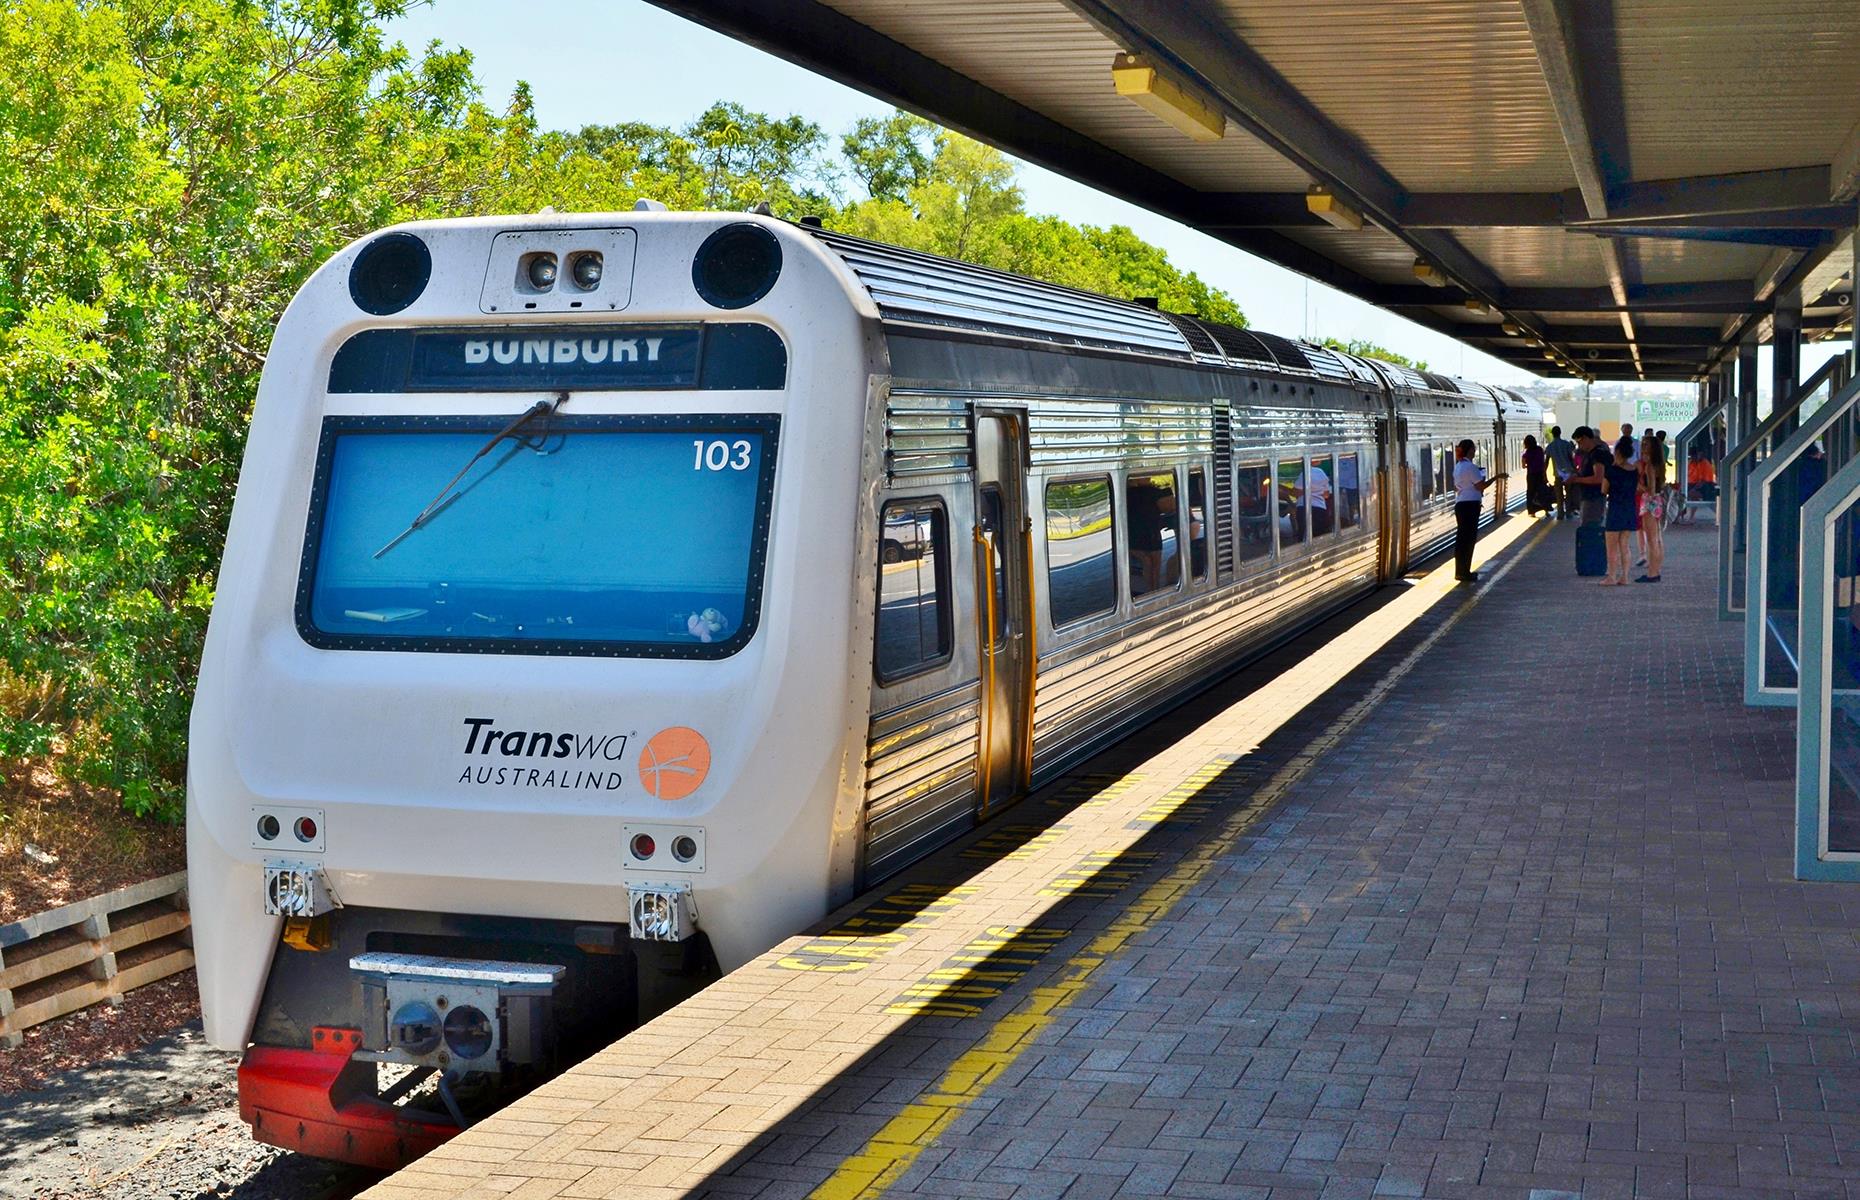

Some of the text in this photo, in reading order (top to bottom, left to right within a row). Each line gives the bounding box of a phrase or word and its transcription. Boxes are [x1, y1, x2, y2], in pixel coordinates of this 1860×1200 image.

[465, 337, 663, 364] BUNBURY
[1655, 401, 1689, 409] BUNBURY
[692, 439, 752, 472] 103
[458, 765, 623, 791] AUSTRALIND
[776, 884, 984, 972] CAUTION
[883, 924, 1072, 1018] DURING
[1033, 850, 1162, 898] TRAIN
